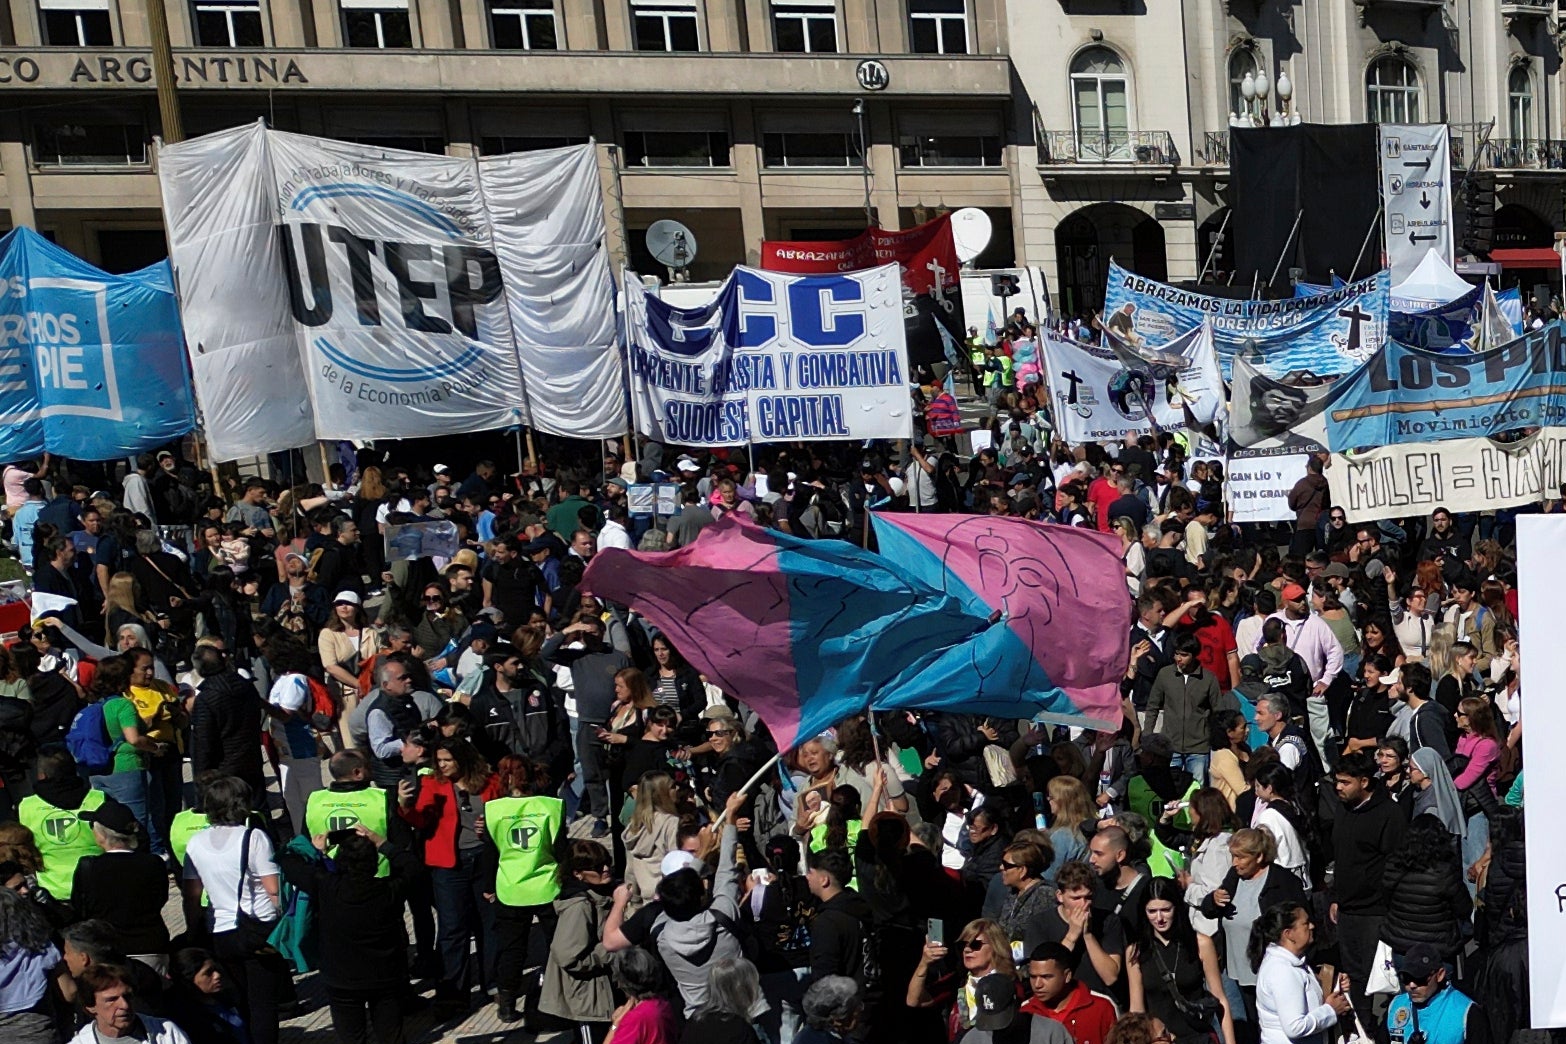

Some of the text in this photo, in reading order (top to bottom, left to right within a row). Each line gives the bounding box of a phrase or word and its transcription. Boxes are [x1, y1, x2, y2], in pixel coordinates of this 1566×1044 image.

[70, 57, 308, 83] ARGNTINA
[275, 222, 504, 341] UTEP
[1123, 275, 1221, 313] ABRAZAMOS
[1224, 301, 1241, 315] LA
[1247, 301, 1281, 316] VIDA
[1284, 294, 1329, 313] COMO
[36, 345, 88, 389] PIE
[322, 363, 339, 382] de
[339, 376, 354, 394] la
[358, 381, 443, 406] Economía
[782, 353, 793, 389] Y
[797, 350, 903, 388] COMBATIVA
[757, 394, 849, 437] CAPITAL
[1397, 408, 1531, 435] Movimiento
[1243, 491, 1257, 499] EN
[1348, 452, 1445, 511] MILEI
